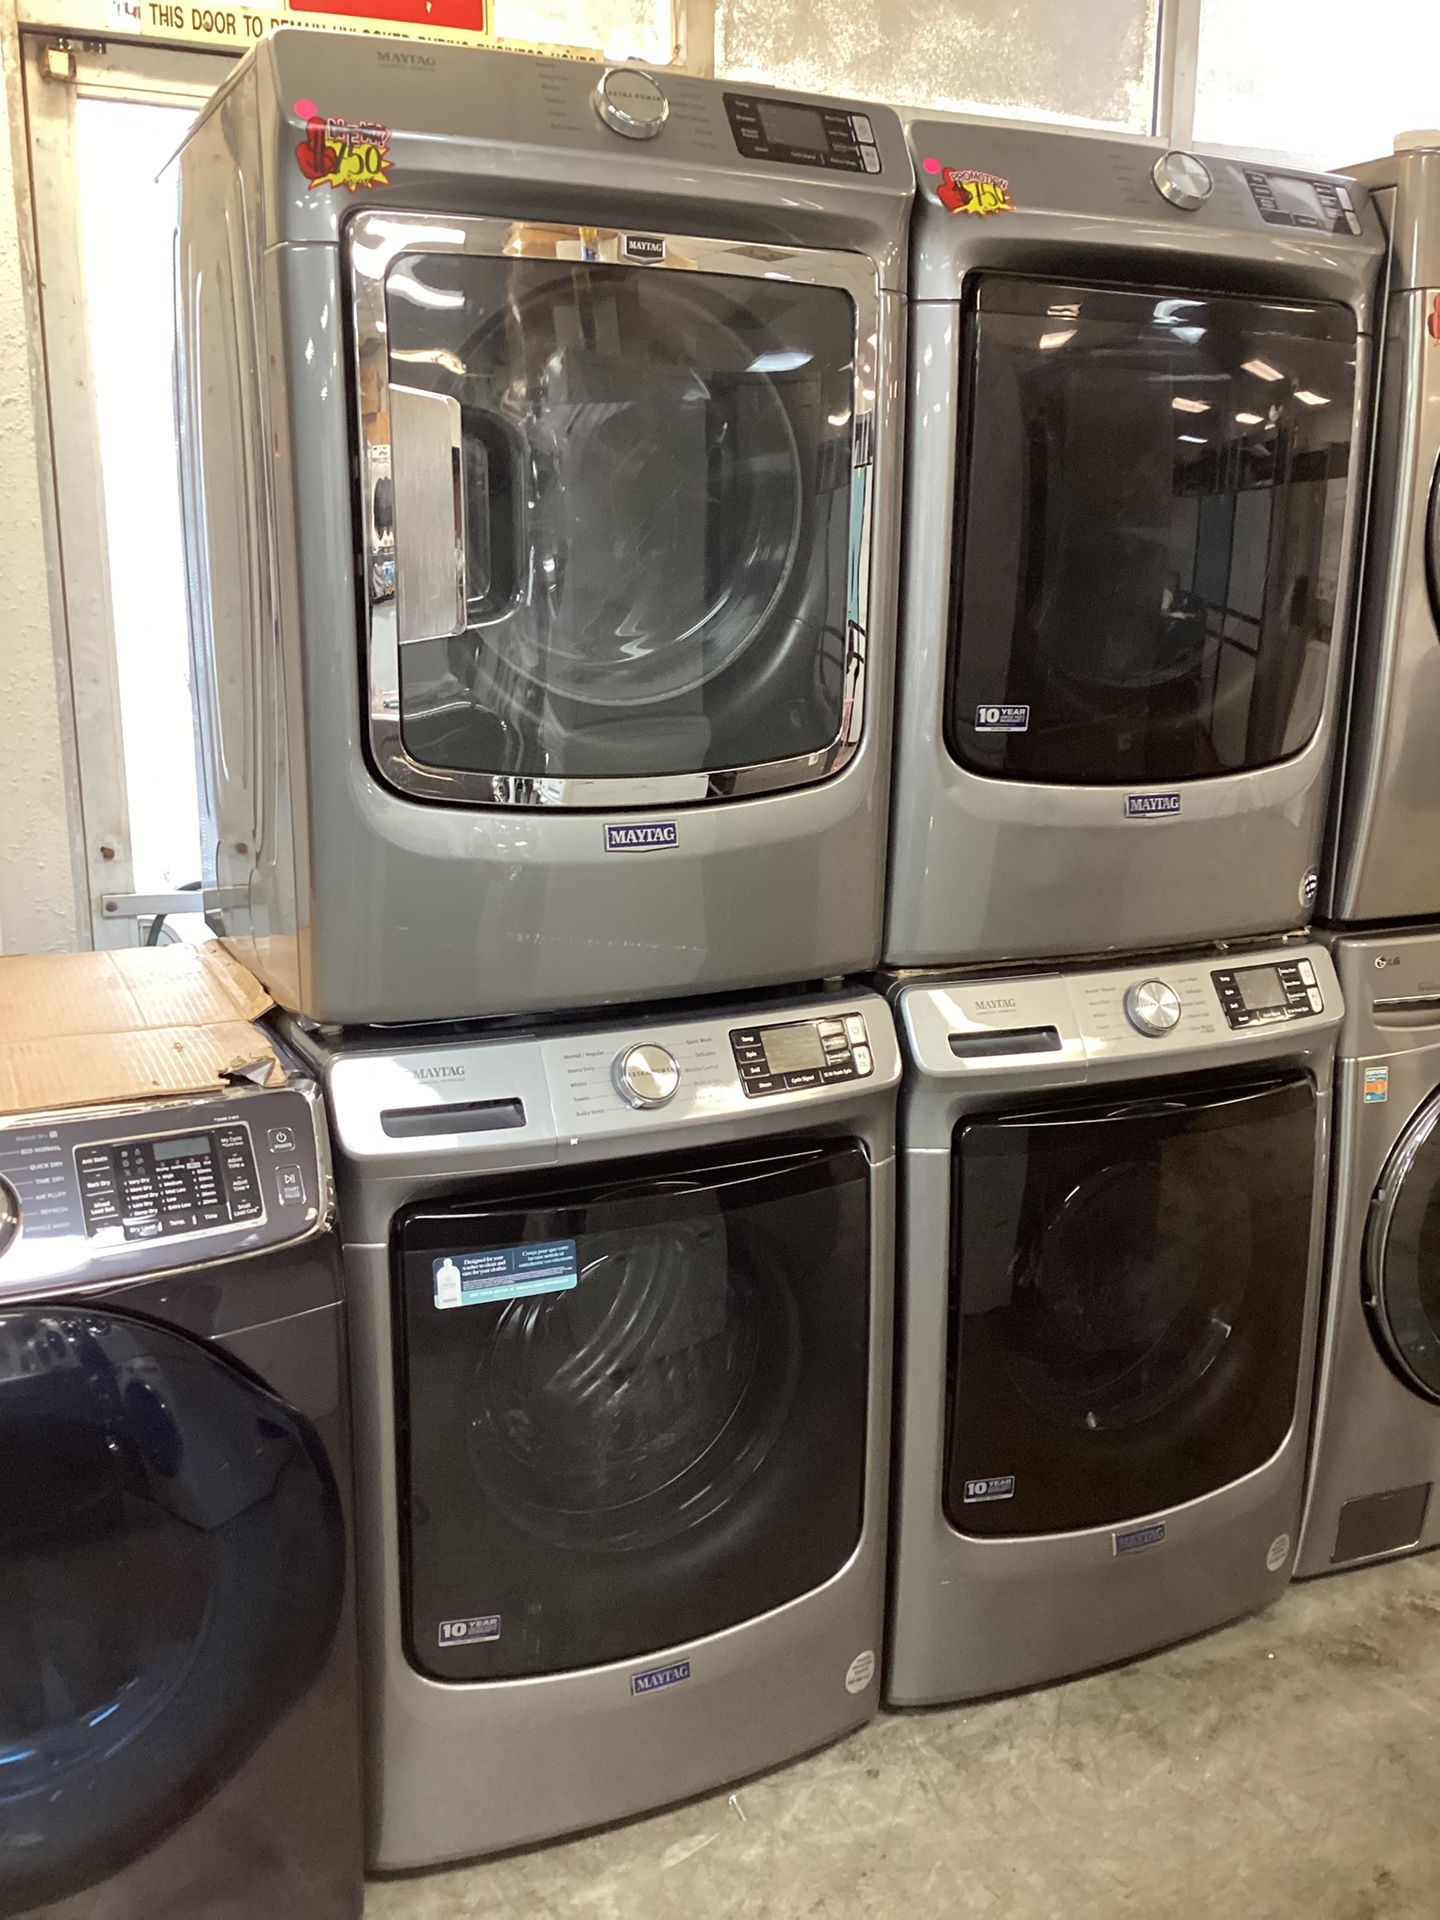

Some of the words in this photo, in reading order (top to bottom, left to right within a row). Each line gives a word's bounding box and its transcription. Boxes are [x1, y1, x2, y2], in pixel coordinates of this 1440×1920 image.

[149, 3, 184, 29] THIS
[191, 8, 236, 35] DOOR
[243, 15, 263, 38] TO
[377, 51, 436, 65] MAYTAG
[949, 170, 1008, 190] PROMOTION
[629, 241, 662, 252] MAYTAG
[979, 708, 1000, 723] 10
[1001, 708, 1026, 716] YEAR
[1130, 797, 1179, 811] MAYTAG
[610, 827, 675, 844] MAYTAG
[975, 998, 1016, 1009] MAYTAG
[413, 1065, 465, 1079] MAYTAG
[29, 1162, 49, 1170] QUICK
[968, 1482, 987, 1495] 10
[443, 1623, 467, 1638] 10
[469, 1619, 497, 1627] YEAR
[637, 1665, 688, 1691] MAYTAG
